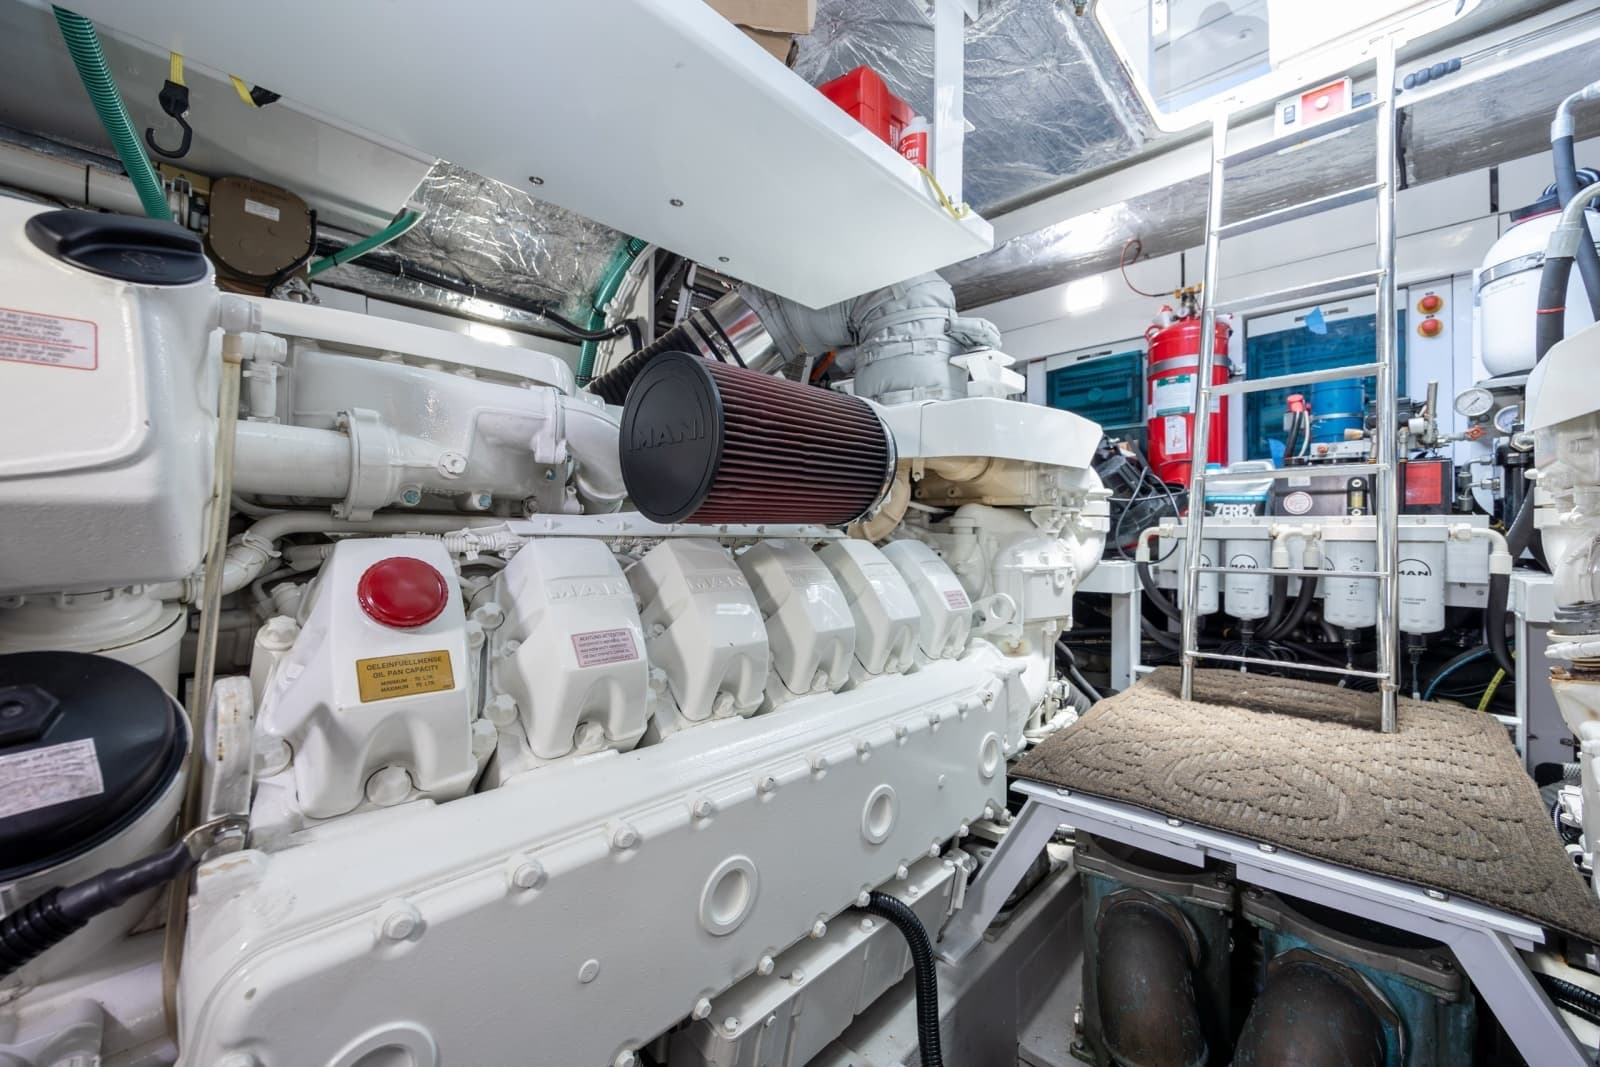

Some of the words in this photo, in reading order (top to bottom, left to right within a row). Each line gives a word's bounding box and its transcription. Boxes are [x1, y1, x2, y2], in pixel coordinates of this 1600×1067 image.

[629, 417, 705, 451] MAN
[1214, 503, 1256, 518] ZEREX
[405, 664, 439, 674] CAPACITY
[381, 684, 409, 692] MAXIMUM
